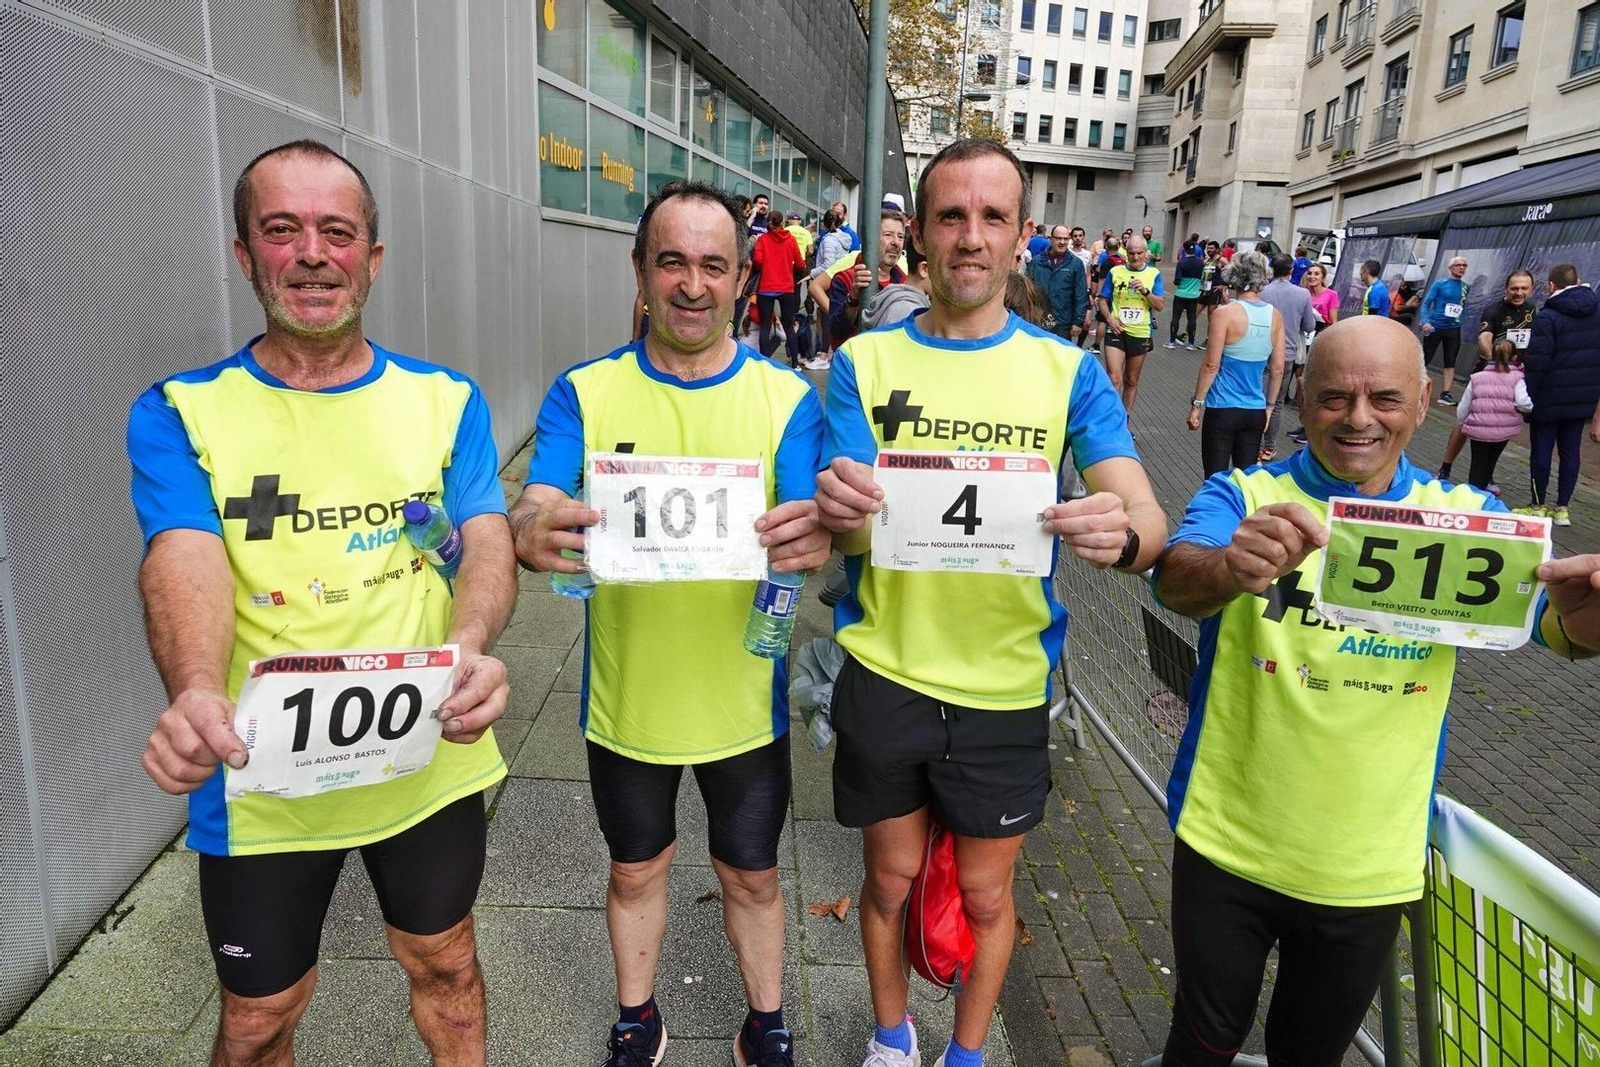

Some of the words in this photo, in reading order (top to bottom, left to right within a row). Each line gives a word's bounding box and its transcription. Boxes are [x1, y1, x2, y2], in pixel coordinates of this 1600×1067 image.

[550, 132, 583, 171] Indoor
[602, 151, 634, 191] Running
[1123, 310, 1140, 319] 137
[1515, 333, 1526, 342] 12
[623, 486, 728, 539] 101
[942, 485, 982, 535] 4
[632, 545, 661, 553] Salvador
[931, 541, 969, 549] NOGUEIRA
[1352, 536, 1504, 606] 513
[1371, 599, 1395, 610] Berto
[1397, 603, 1426, 614] VIEITO
[1431, 607, 1472, 619] QUINTAS
[1337, 635, 1433, 660] Atlántico
[1370, 683, 1393, 694] auga
[283, 683, 423, 753] 100
[295, 759, 312, 768] Luis
[314, 753, 351, 765] ALONSO
[354, 749, 386, 760] BASTOS
